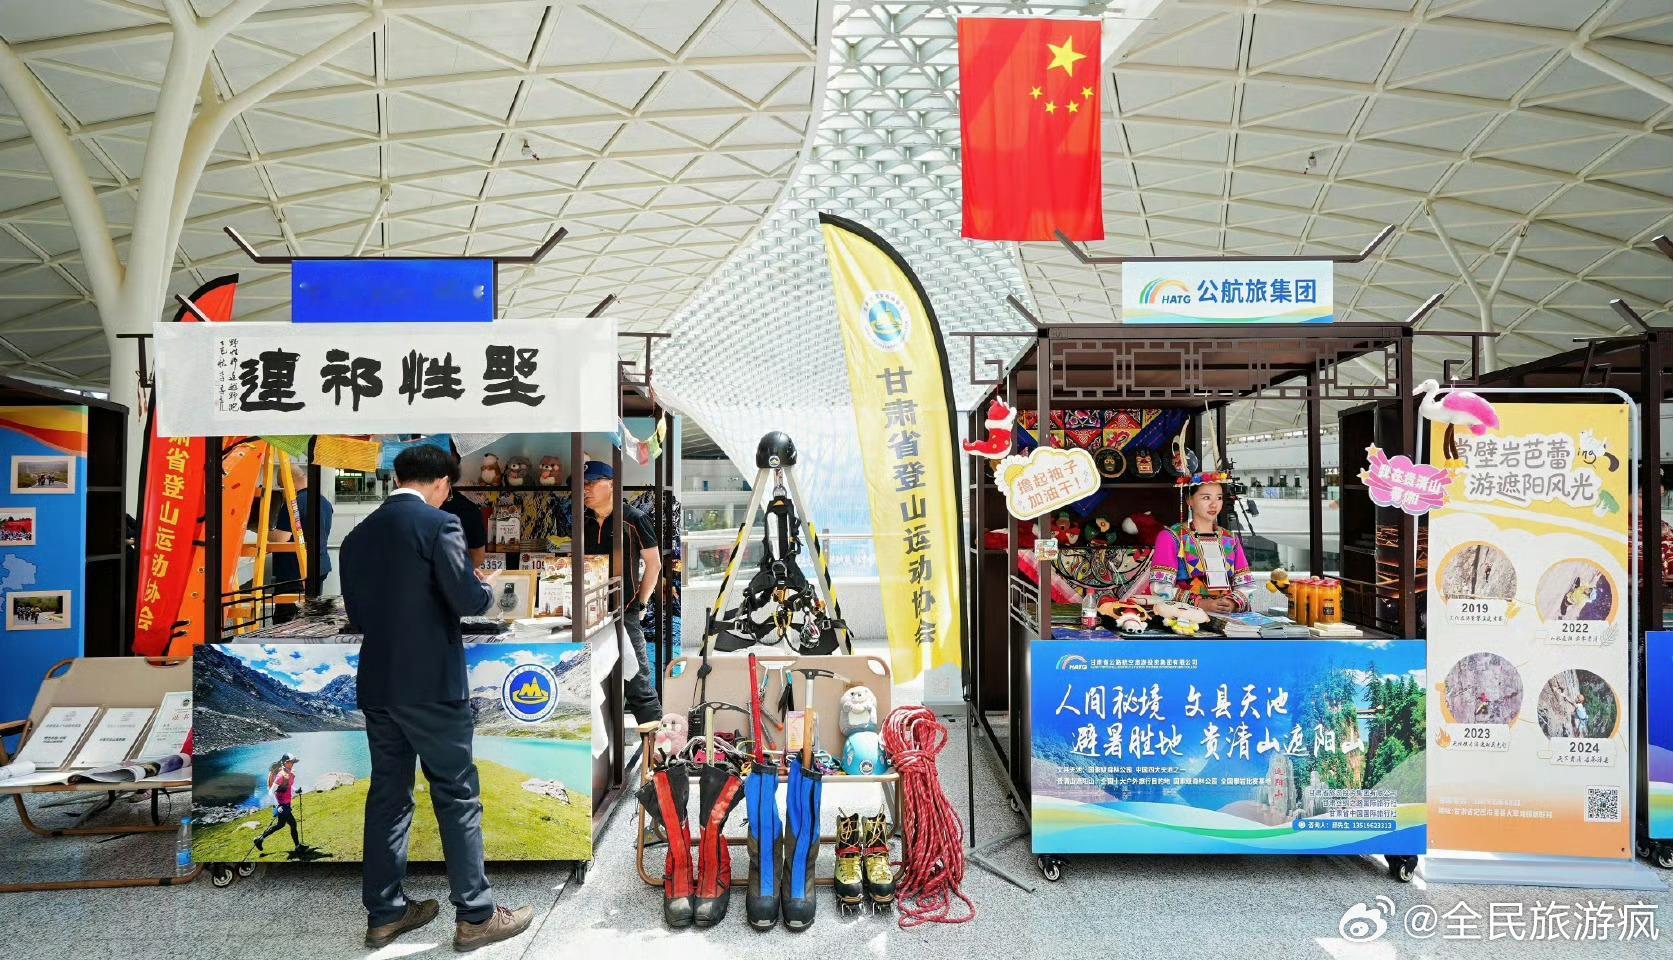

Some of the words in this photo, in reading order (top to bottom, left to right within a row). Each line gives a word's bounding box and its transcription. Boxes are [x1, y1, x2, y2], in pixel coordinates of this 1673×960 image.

[1162, 295, 1191, 304] HATG
[1197, 278, 1317, 304] 公航旅集团
[1469, 471, 1594, 502] 游遮阳风光
[876, 365, 937, 647] 甘肃省登山运动协会
[1462, 603, 1489, 613] 2019
[1562, 623, 1589, 633] 2022
[1055, 683, 1166, 721] 人间秘境
[1184, 683, 1289, 720] 文县天池
[1070, 722, 1184, 760] 避暑胜地
[1200, 721, 1366, 760] 贵清山遮阳山
[1464, 728, 1491, 739] 2023
[1570, 741, 1600, 753] 2024
